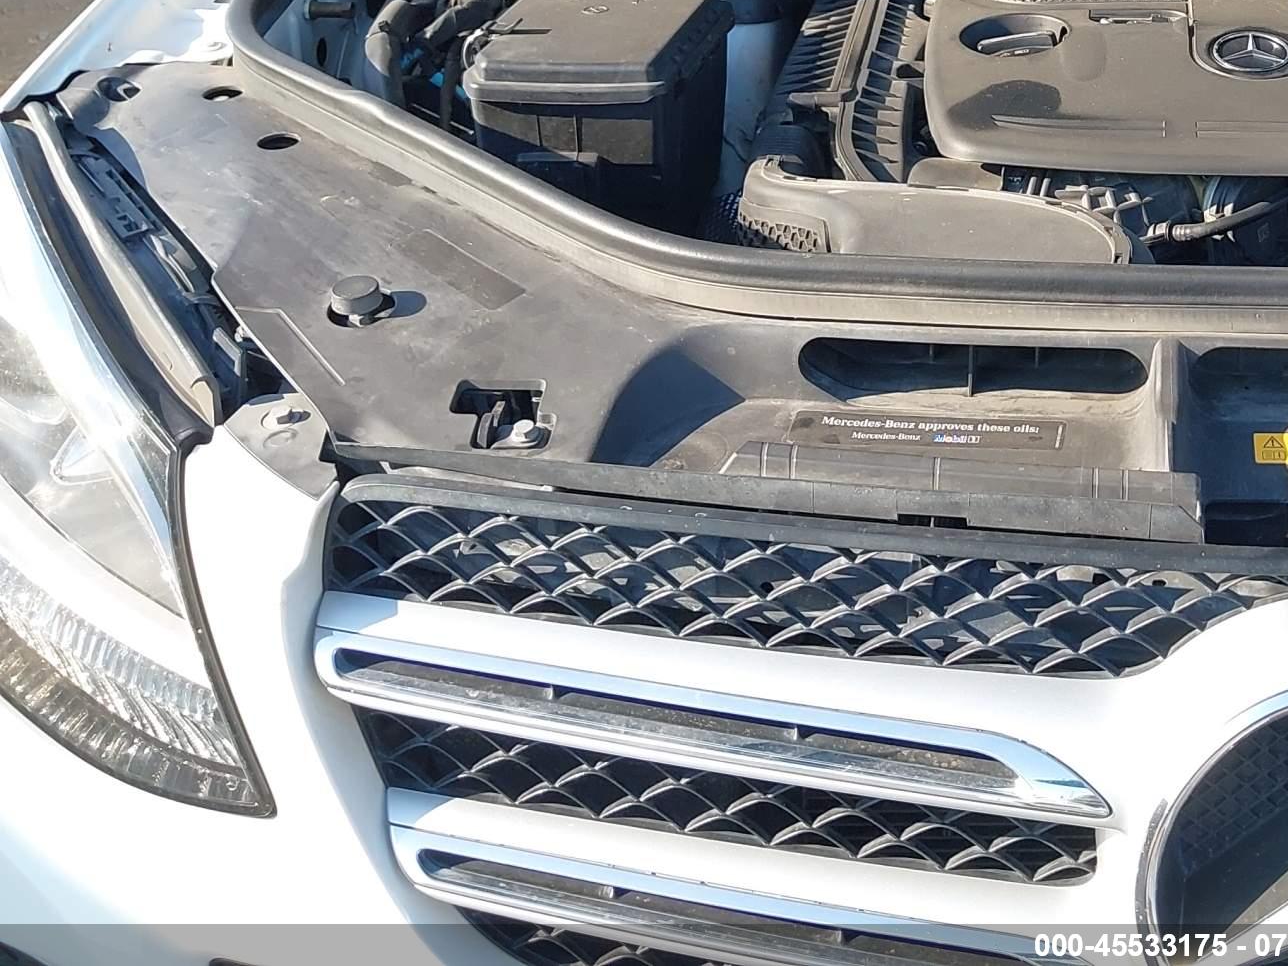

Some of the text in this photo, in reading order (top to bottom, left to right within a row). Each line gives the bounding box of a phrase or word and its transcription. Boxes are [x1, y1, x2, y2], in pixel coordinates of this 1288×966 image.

[822, 416, 915, 429] Mercedes-Benz
[918, 422, 974, 432] approves
[977, 423, 1010, 432] these
[851, 432, 920, 441] Mercedes-Benz
[934, 435, 967, 443] Mobil
